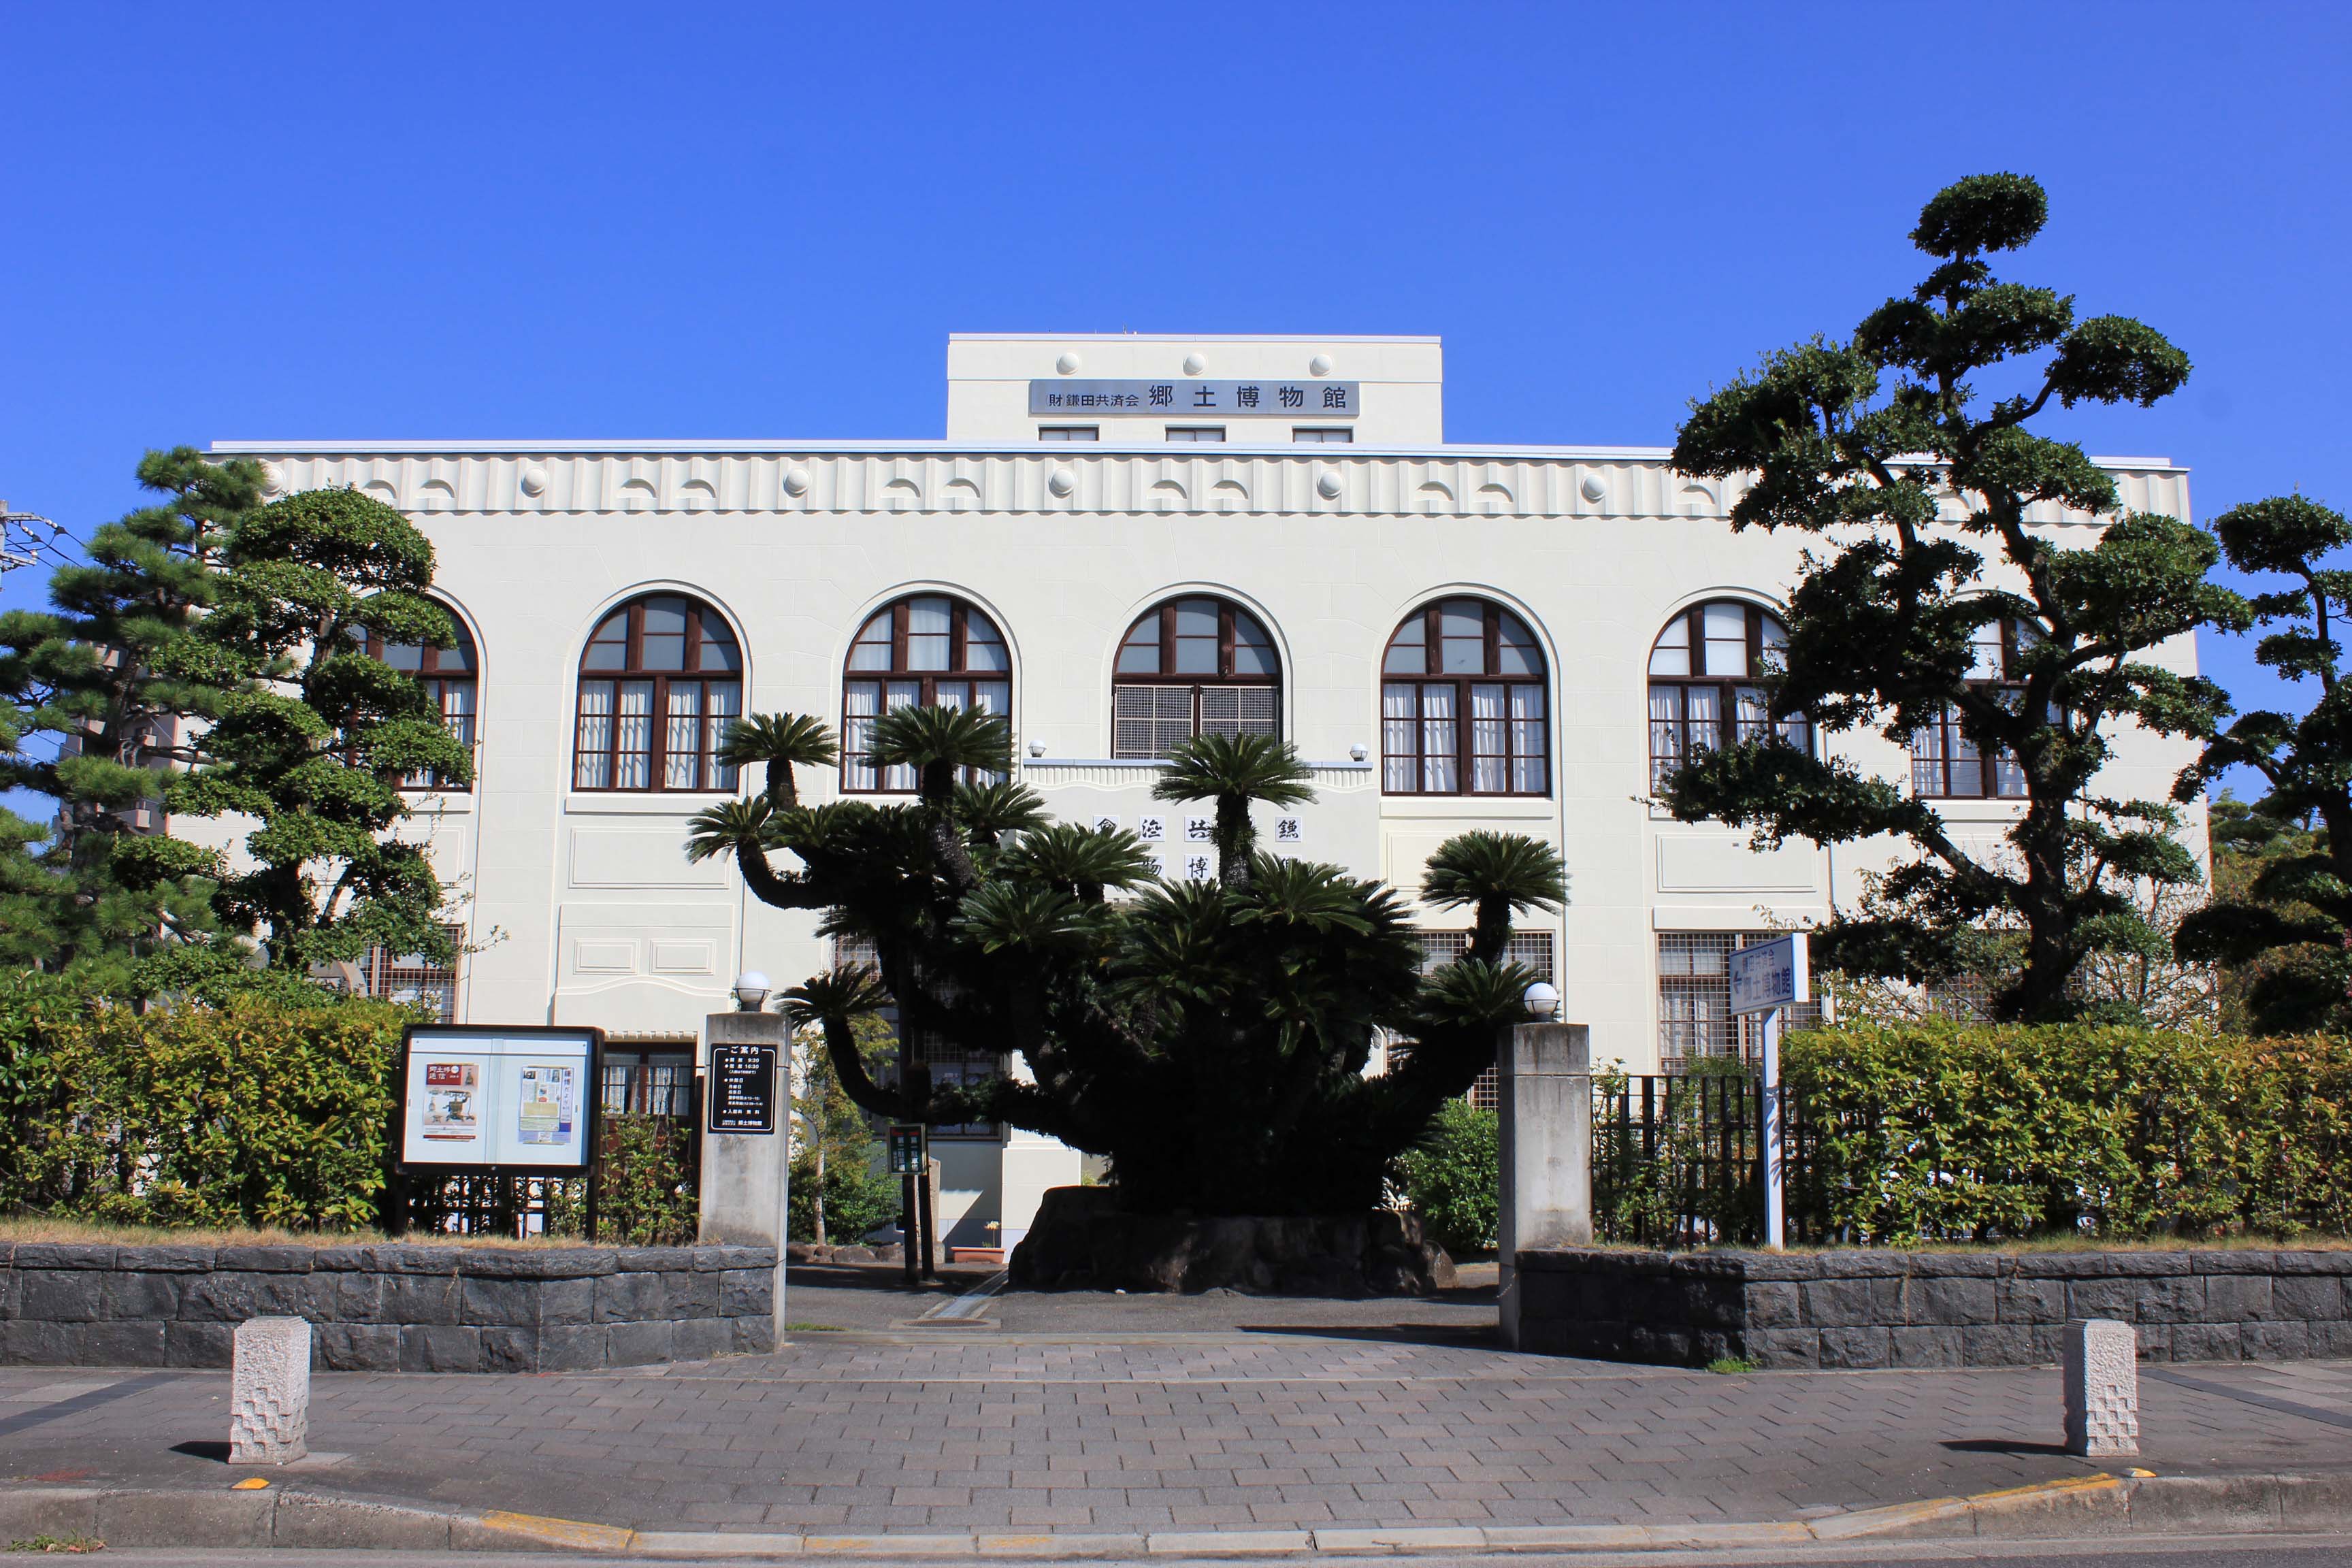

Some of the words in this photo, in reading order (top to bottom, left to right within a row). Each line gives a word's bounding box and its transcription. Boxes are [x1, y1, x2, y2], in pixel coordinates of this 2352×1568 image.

[1148, 385, 1347, 408] 郷土博物館
[730, 1045, 760, 1055] ご案内
